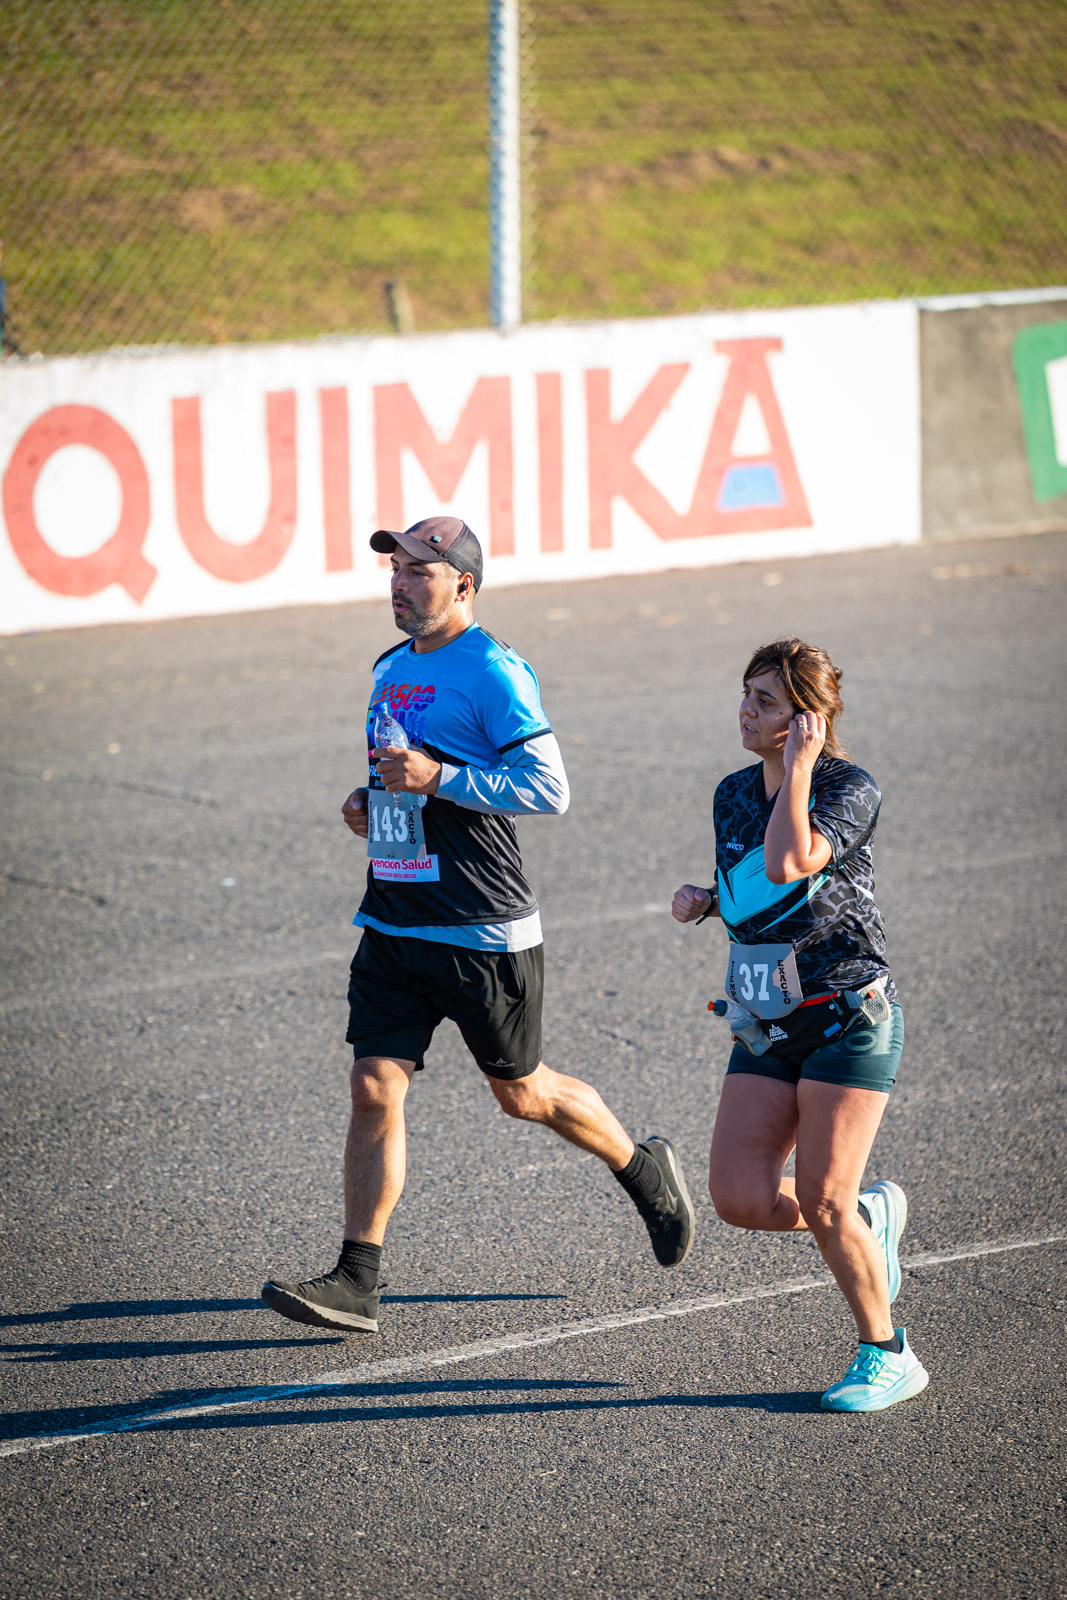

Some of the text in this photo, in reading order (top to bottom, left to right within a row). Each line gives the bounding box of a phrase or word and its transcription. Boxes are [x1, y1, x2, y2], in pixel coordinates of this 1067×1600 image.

[2, 337, 812, 604] QUIMIKA
[411, 694, 436, 703] MILLAS
[372, 805, 408, 842] 143
[407, 806, 417, 844] XACTO
[401, 857, 432, 870] Salud
[739, 963, 770, 1001] 37
[777, 960, 791, 1005] EXACTO
